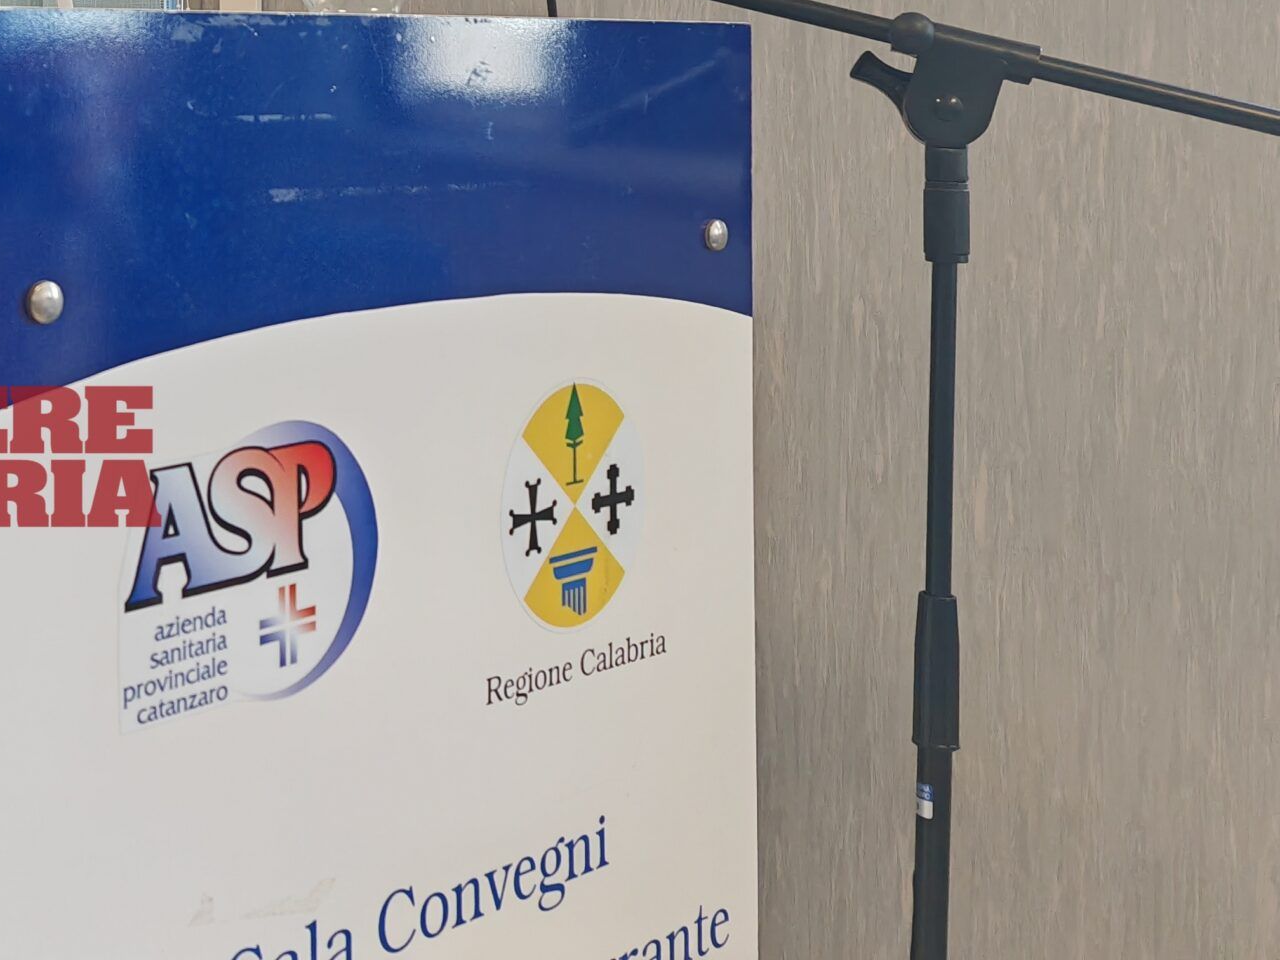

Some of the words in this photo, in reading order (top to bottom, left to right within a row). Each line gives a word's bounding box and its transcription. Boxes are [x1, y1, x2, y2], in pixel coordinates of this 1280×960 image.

[124, 439, 338, 614] ASP
[154, 606, 227, 642] azienda
[150, 633, 227, 669] sanitaria
[486, 661, 573, 706] Regione
[580, 633, 667, 677] Calabria
[123, 658, 228, 709] provinciale
[137, 685, 228, 724] catanzaro
[377, 815, 610, 953] Convegni
